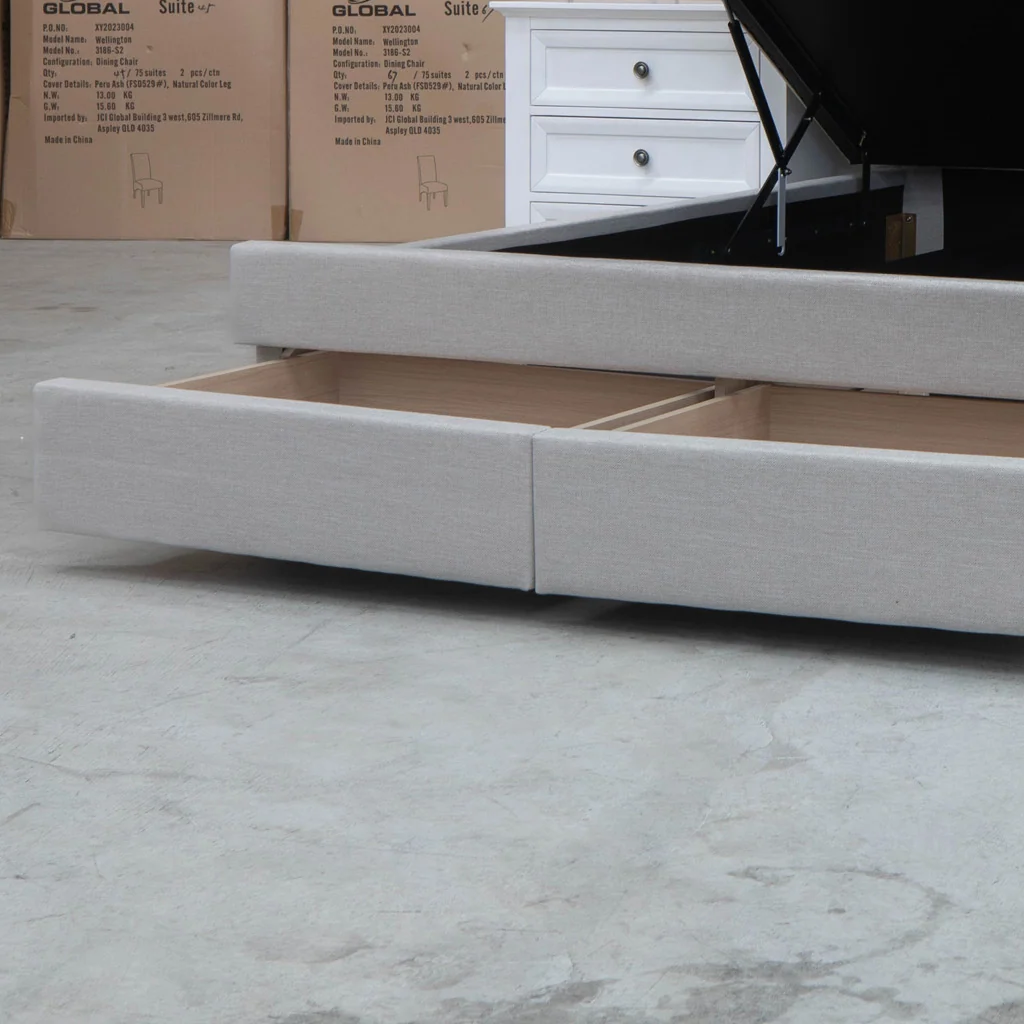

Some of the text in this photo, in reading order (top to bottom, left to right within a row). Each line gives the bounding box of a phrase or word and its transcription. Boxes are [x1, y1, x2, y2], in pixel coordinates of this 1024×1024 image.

[43, 2, 130, 15] GLOBAL
[160, 0, 195, 14] Suite
[332, 4, 416, 17] GLOBAL
[445, 1, 479, 16] Suite
[384, 60, 406, 69] Dining
[407, 60, 425, 68] Chair
[96, 91, 115, 99] 13.00
[96, 102, 115, 110] 15.60
[125, 102, 134, 110] KG
